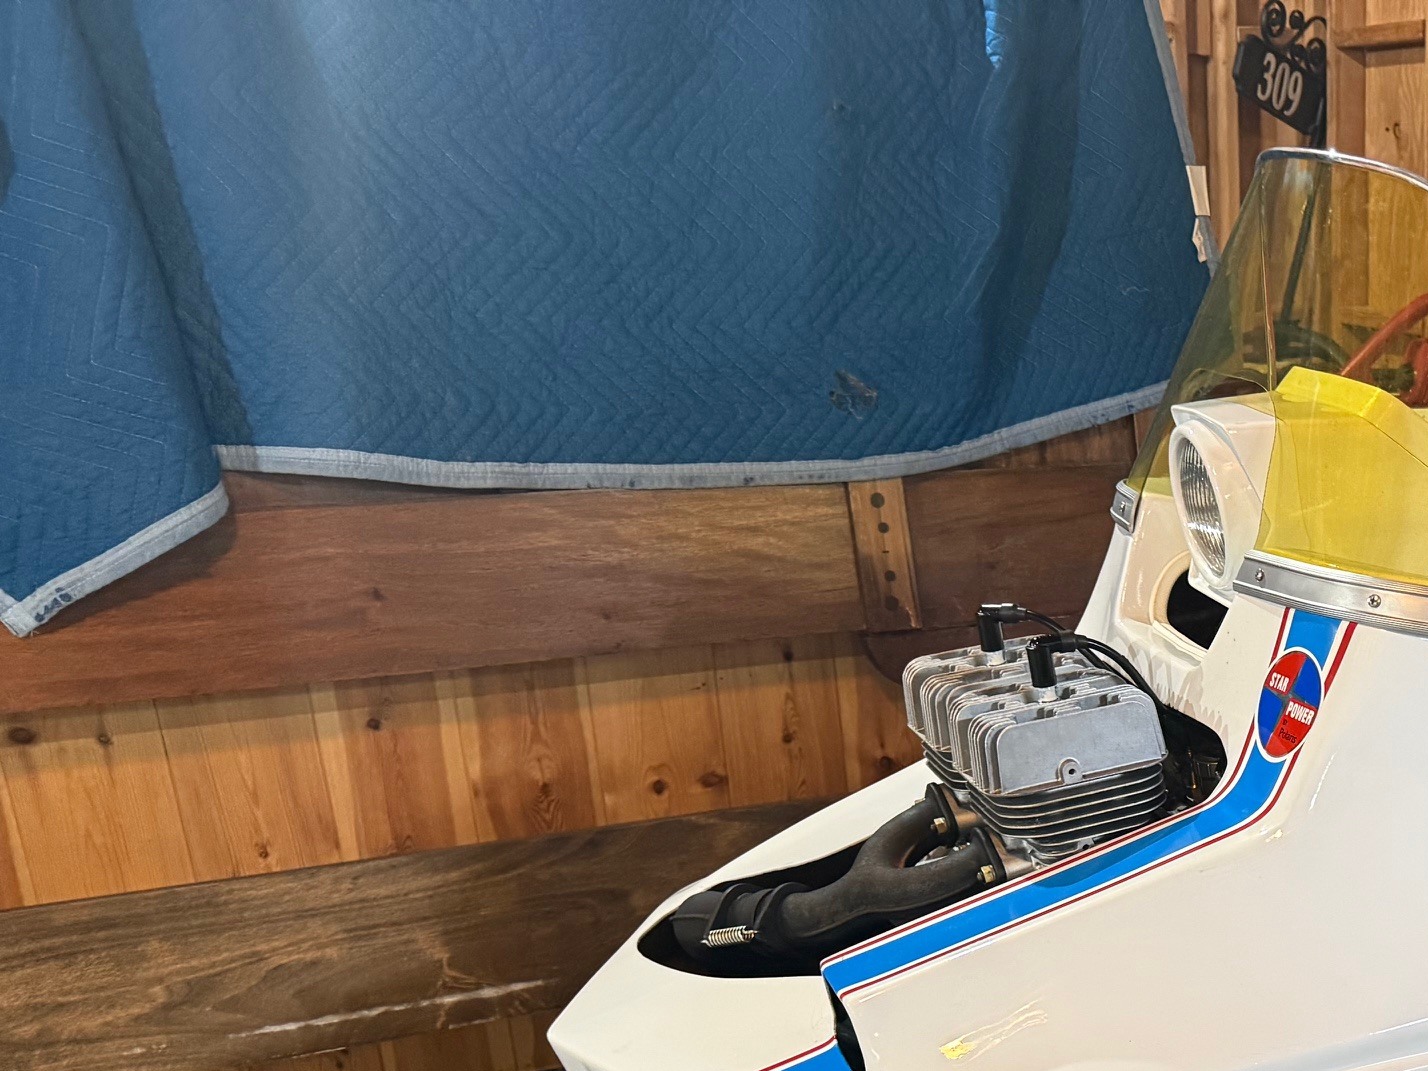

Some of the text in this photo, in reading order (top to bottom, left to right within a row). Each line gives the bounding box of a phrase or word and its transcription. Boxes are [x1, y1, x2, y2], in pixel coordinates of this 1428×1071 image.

[1257, 52, 1303, 116] 309
[1269, 672, 1289, 693] STAR
[1285, 701, 1315, 726] POWER
